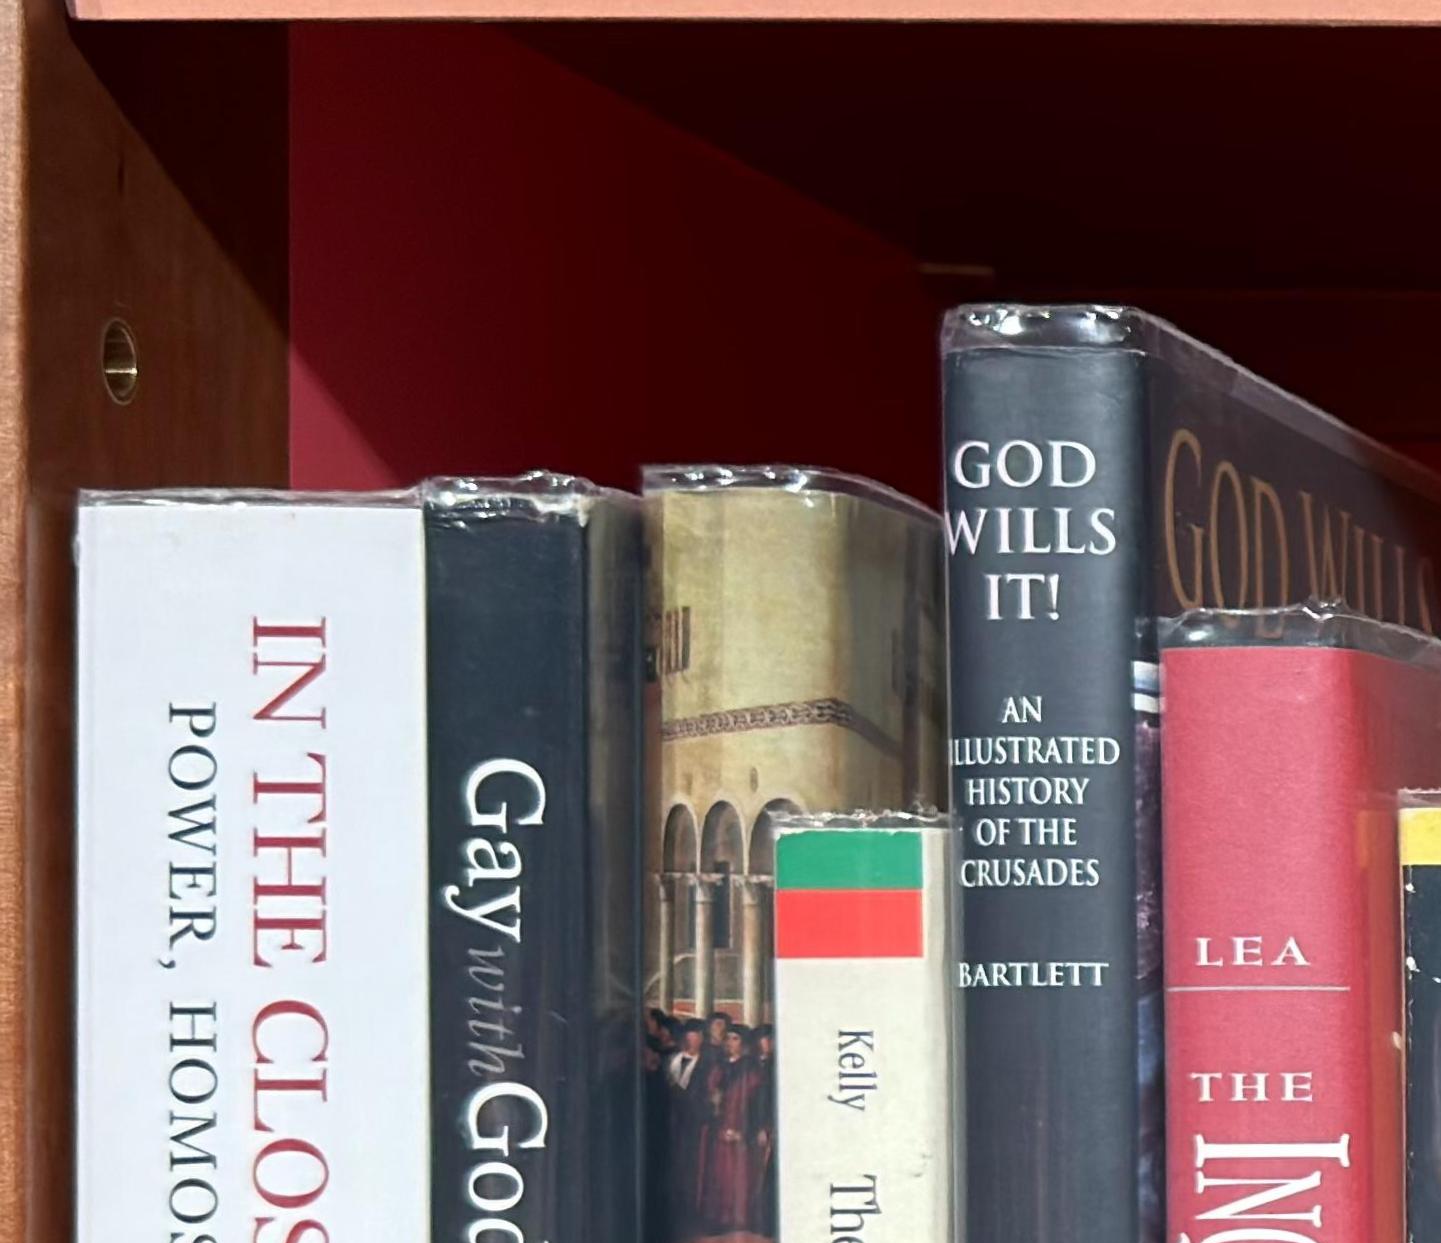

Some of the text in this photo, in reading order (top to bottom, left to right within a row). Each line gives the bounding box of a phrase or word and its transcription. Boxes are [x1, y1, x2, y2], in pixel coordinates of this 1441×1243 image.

[955, 440, 1095, 489] GOD
[945, 508, 1117, 556] WILLS
[984, 573, 1062, 621] IT!
[252, 616, 327, 729] IN
[1001, 697, 1043, 724] AN
[948, 737, 1121, 766] ILLUSTRATED
[966, 778, 1089, 806] HISTORY
[156, 702, 217, 970] POWER,
[445, 758, 546, 941] Gay
[975, 818, 1078, 846] OF THE
[252, 751, 327, 968] THE
[960, 859, 1100, 887] CRUSADES
[957, 962, 1109, 988] BARTLETT
[1195, 937, 1311, 967] LEA
[467, 947, 525, 1078] with
[829, 1030, 875, 1111] Kelly
[1190, 1070, 1314, 1102] THE
